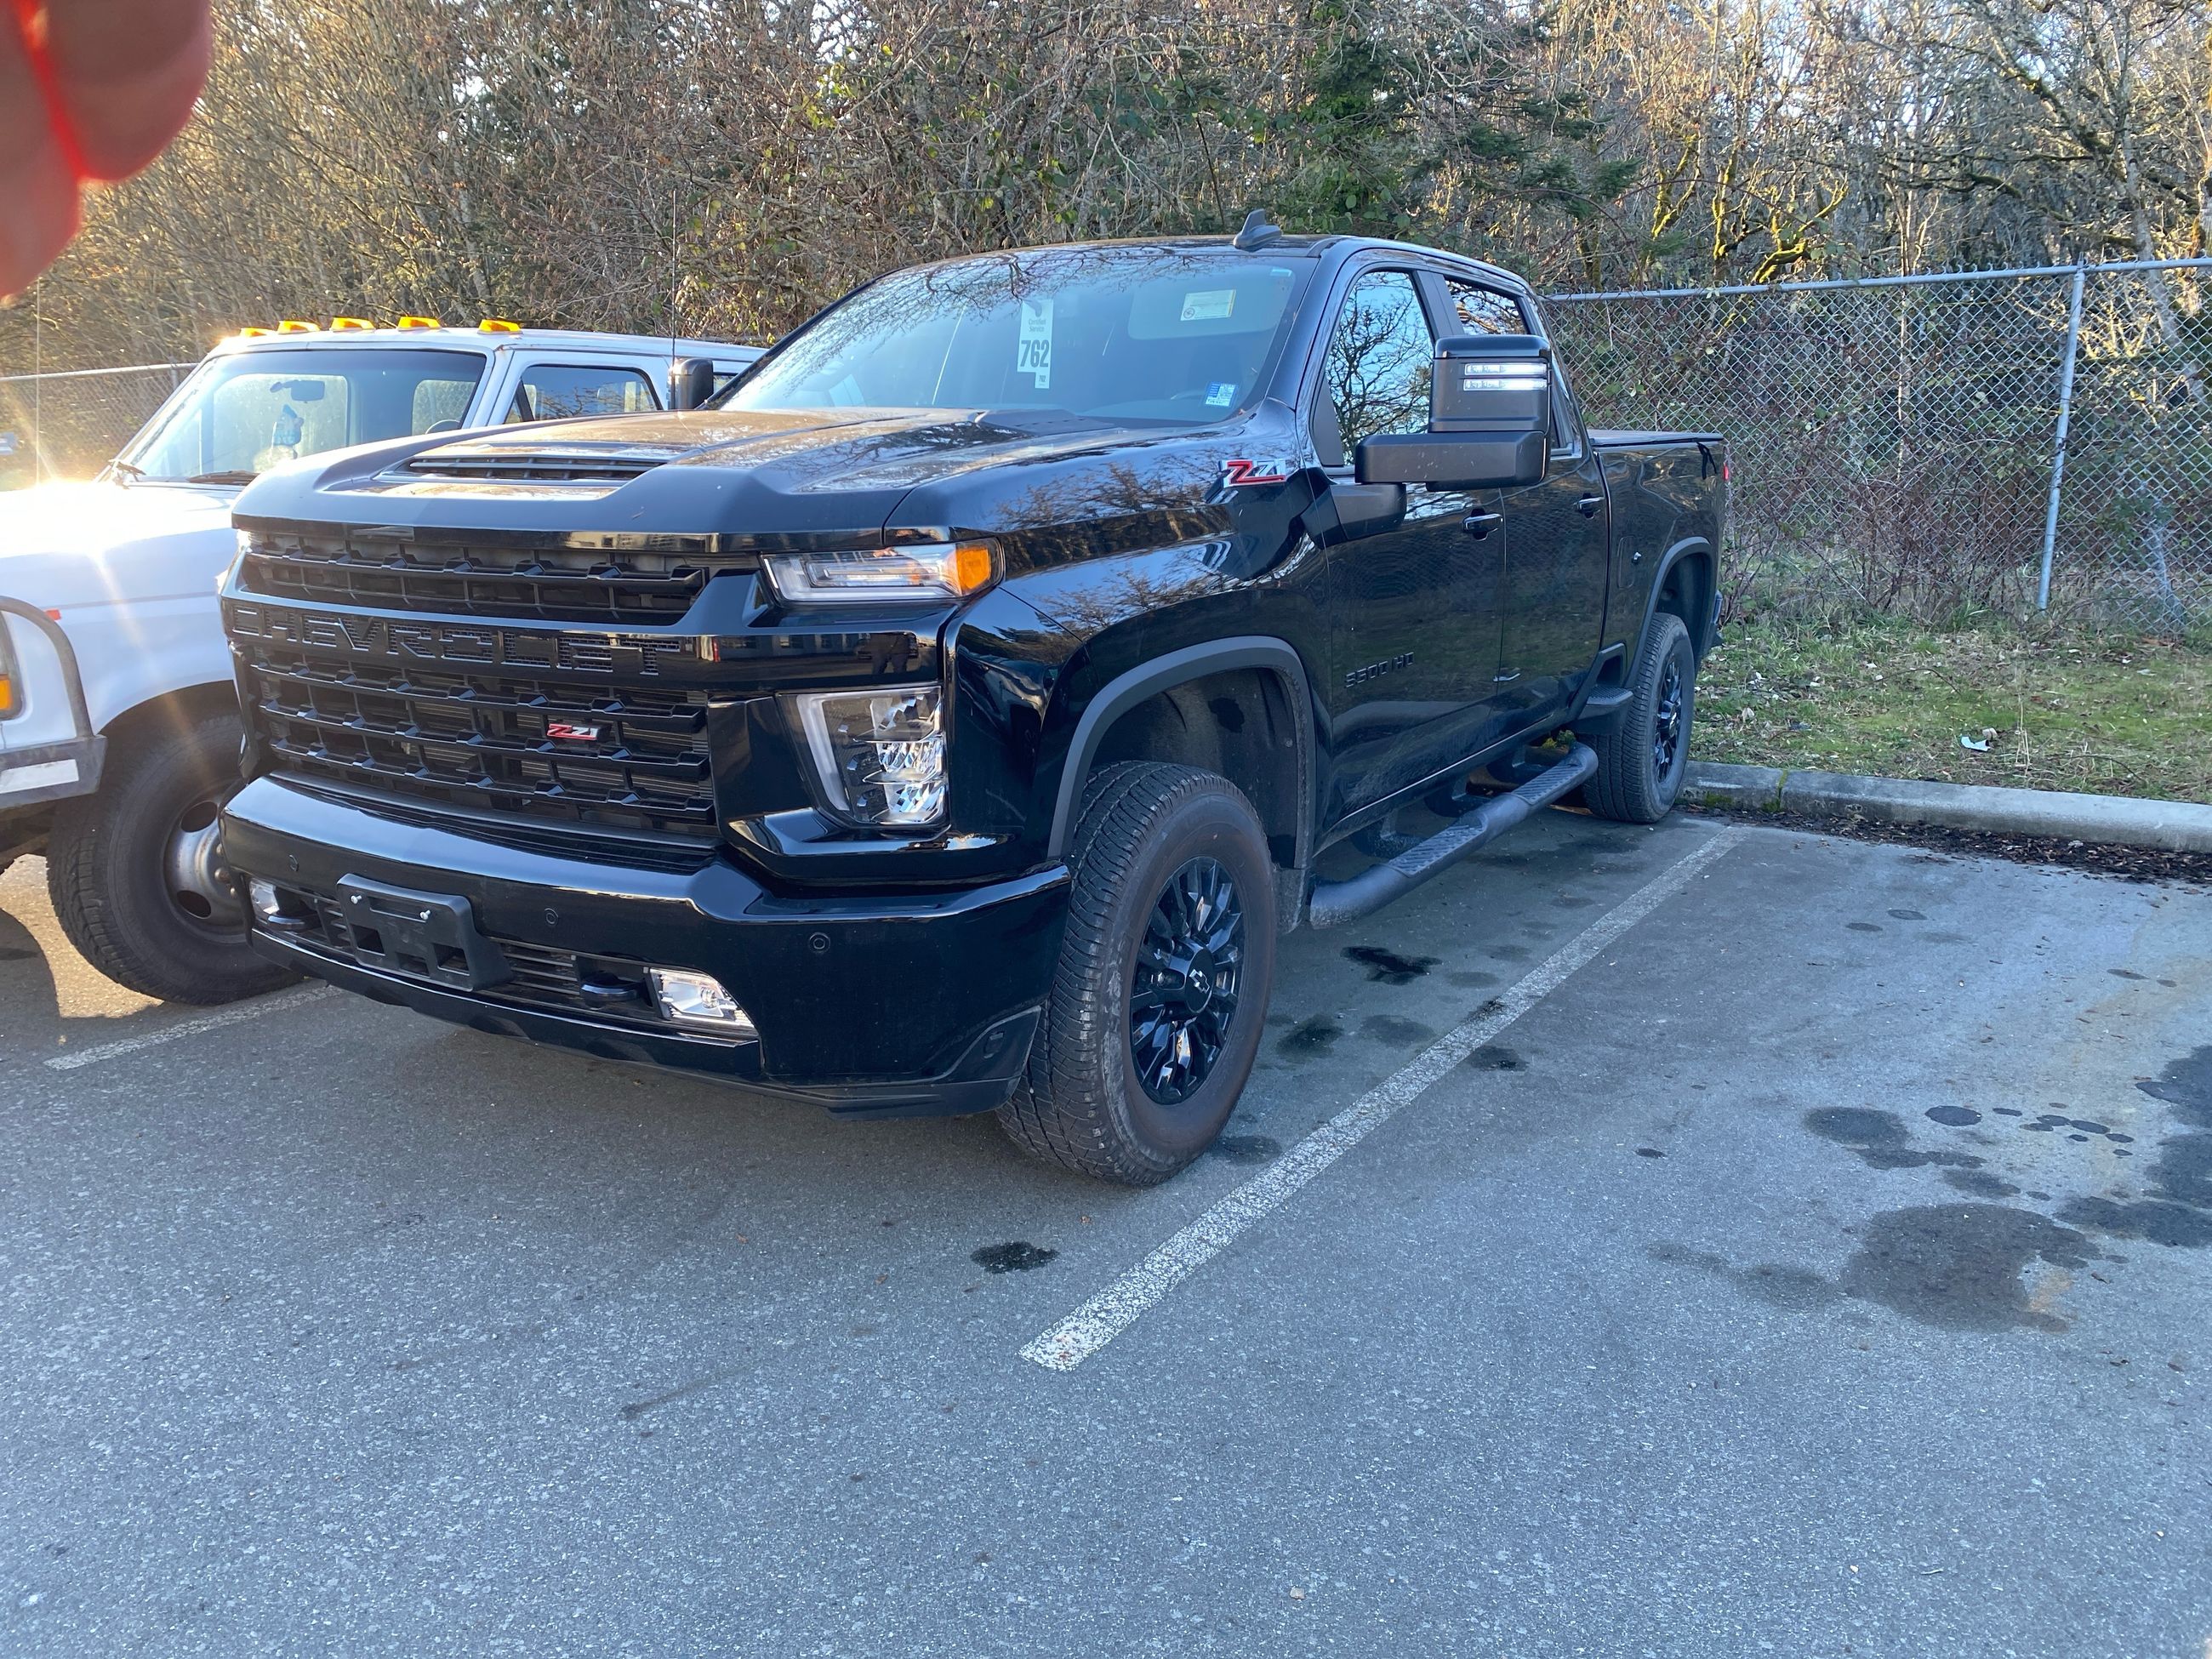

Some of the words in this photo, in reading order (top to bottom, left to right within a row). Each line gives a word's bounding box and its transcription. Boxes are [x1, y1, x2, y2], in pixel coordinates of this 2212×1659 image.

[1020, 339, 1050, 368] 762
[1222, 459, 1286, 487] Z71
[231, 605, 681, 676] CHEVROLET
[1392, 651, 1414, 671] HD
[547, 723, 598, 741] Z71
